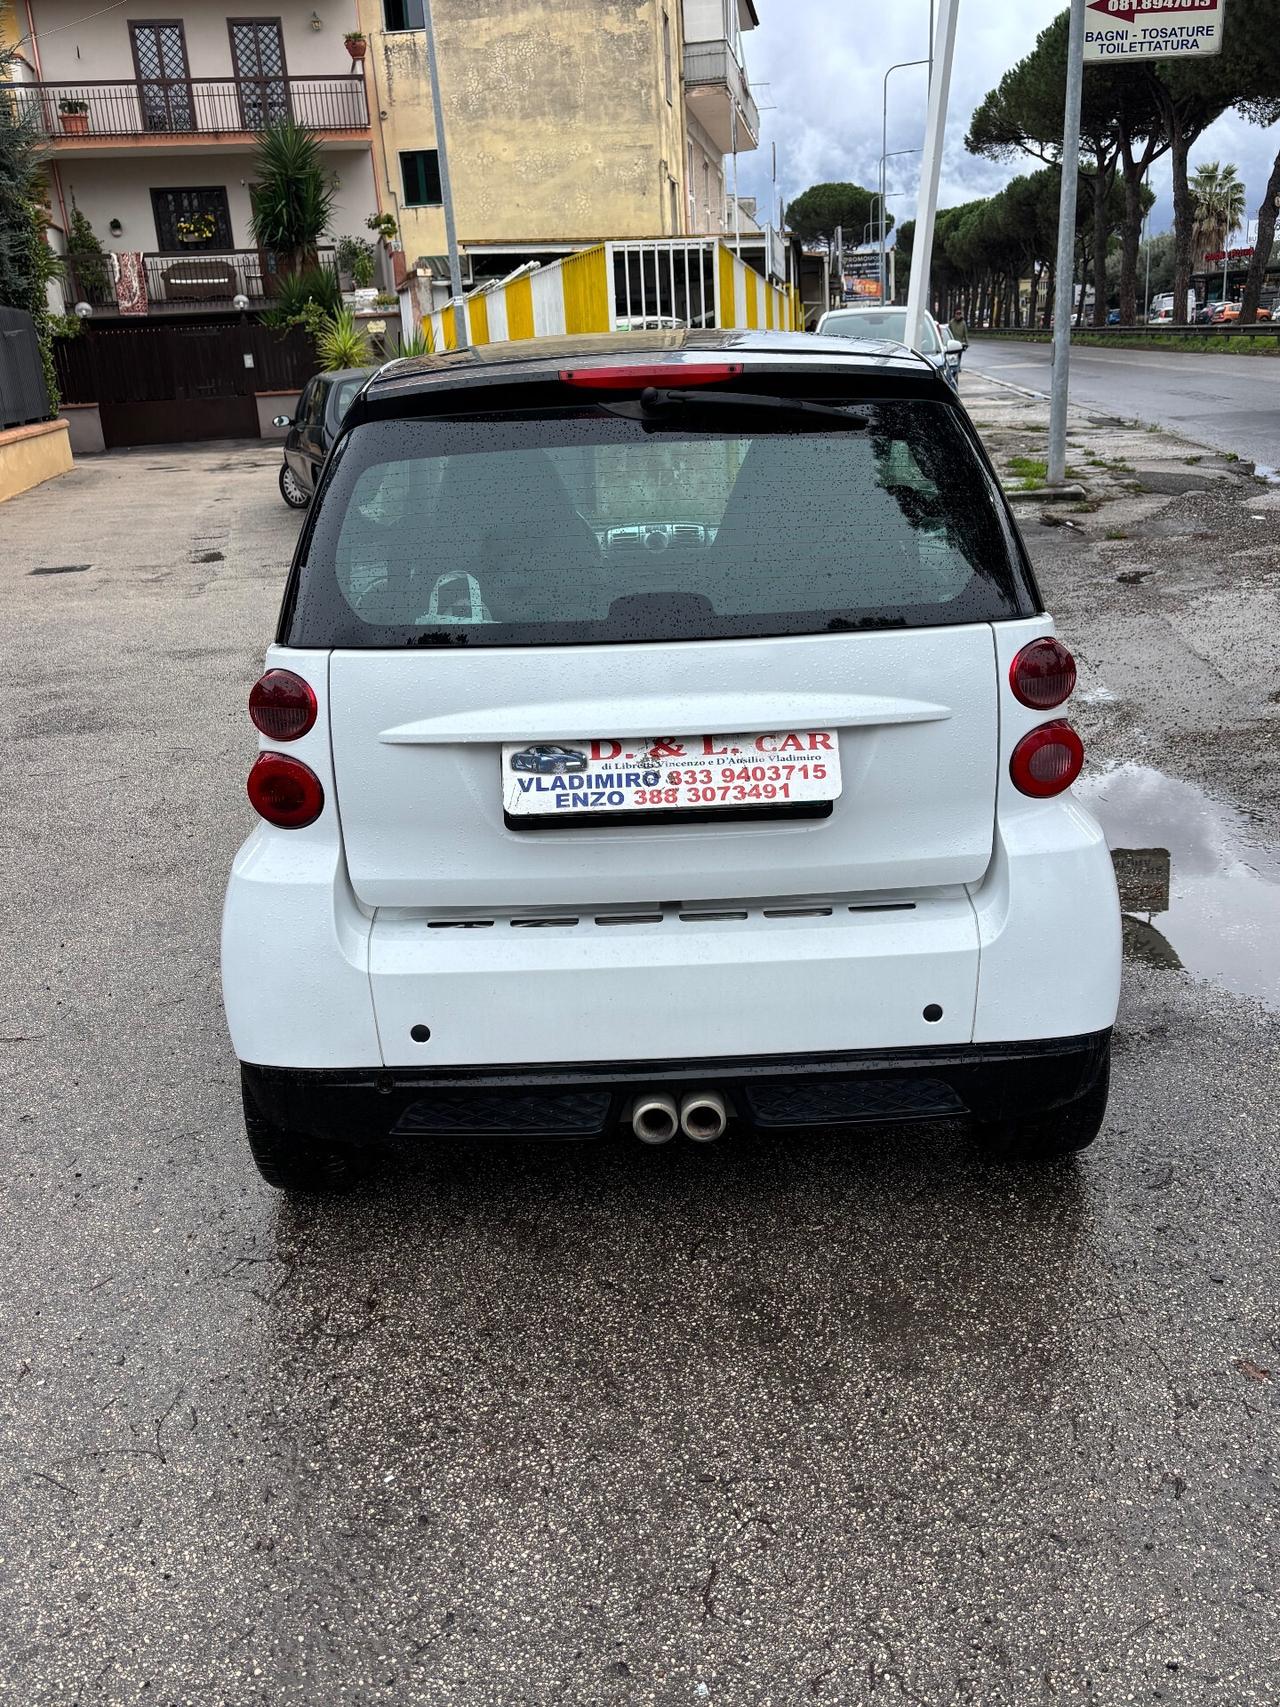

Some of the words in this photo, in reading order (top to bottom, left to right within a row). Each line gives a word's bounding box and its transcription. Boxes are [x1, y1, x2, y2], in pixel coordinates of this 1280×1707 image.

[1085, 30, 1129, 42] BAGNI
[1141, 25, 1215, 39] TOSATURE
[1098, 38, 1200, 54] TOILETTATURA
[589, 739, 634, 761] D.
[649, 736, 688, 758] &
[754, 732, 835, 752] CAR
[601, 762, 612, 770] di
[659, 760, 706, 768] Vincenzo
[768, 753, 822, 762] Vladimiro
[517, 772, 661, 793] VLADIMIRO
[721, 763, 827, 783] 9403715
[555, 790, 625, 808] ENZO
[633, 787, 678, 805] 388
[686, 783, 791, 802] 3073491
